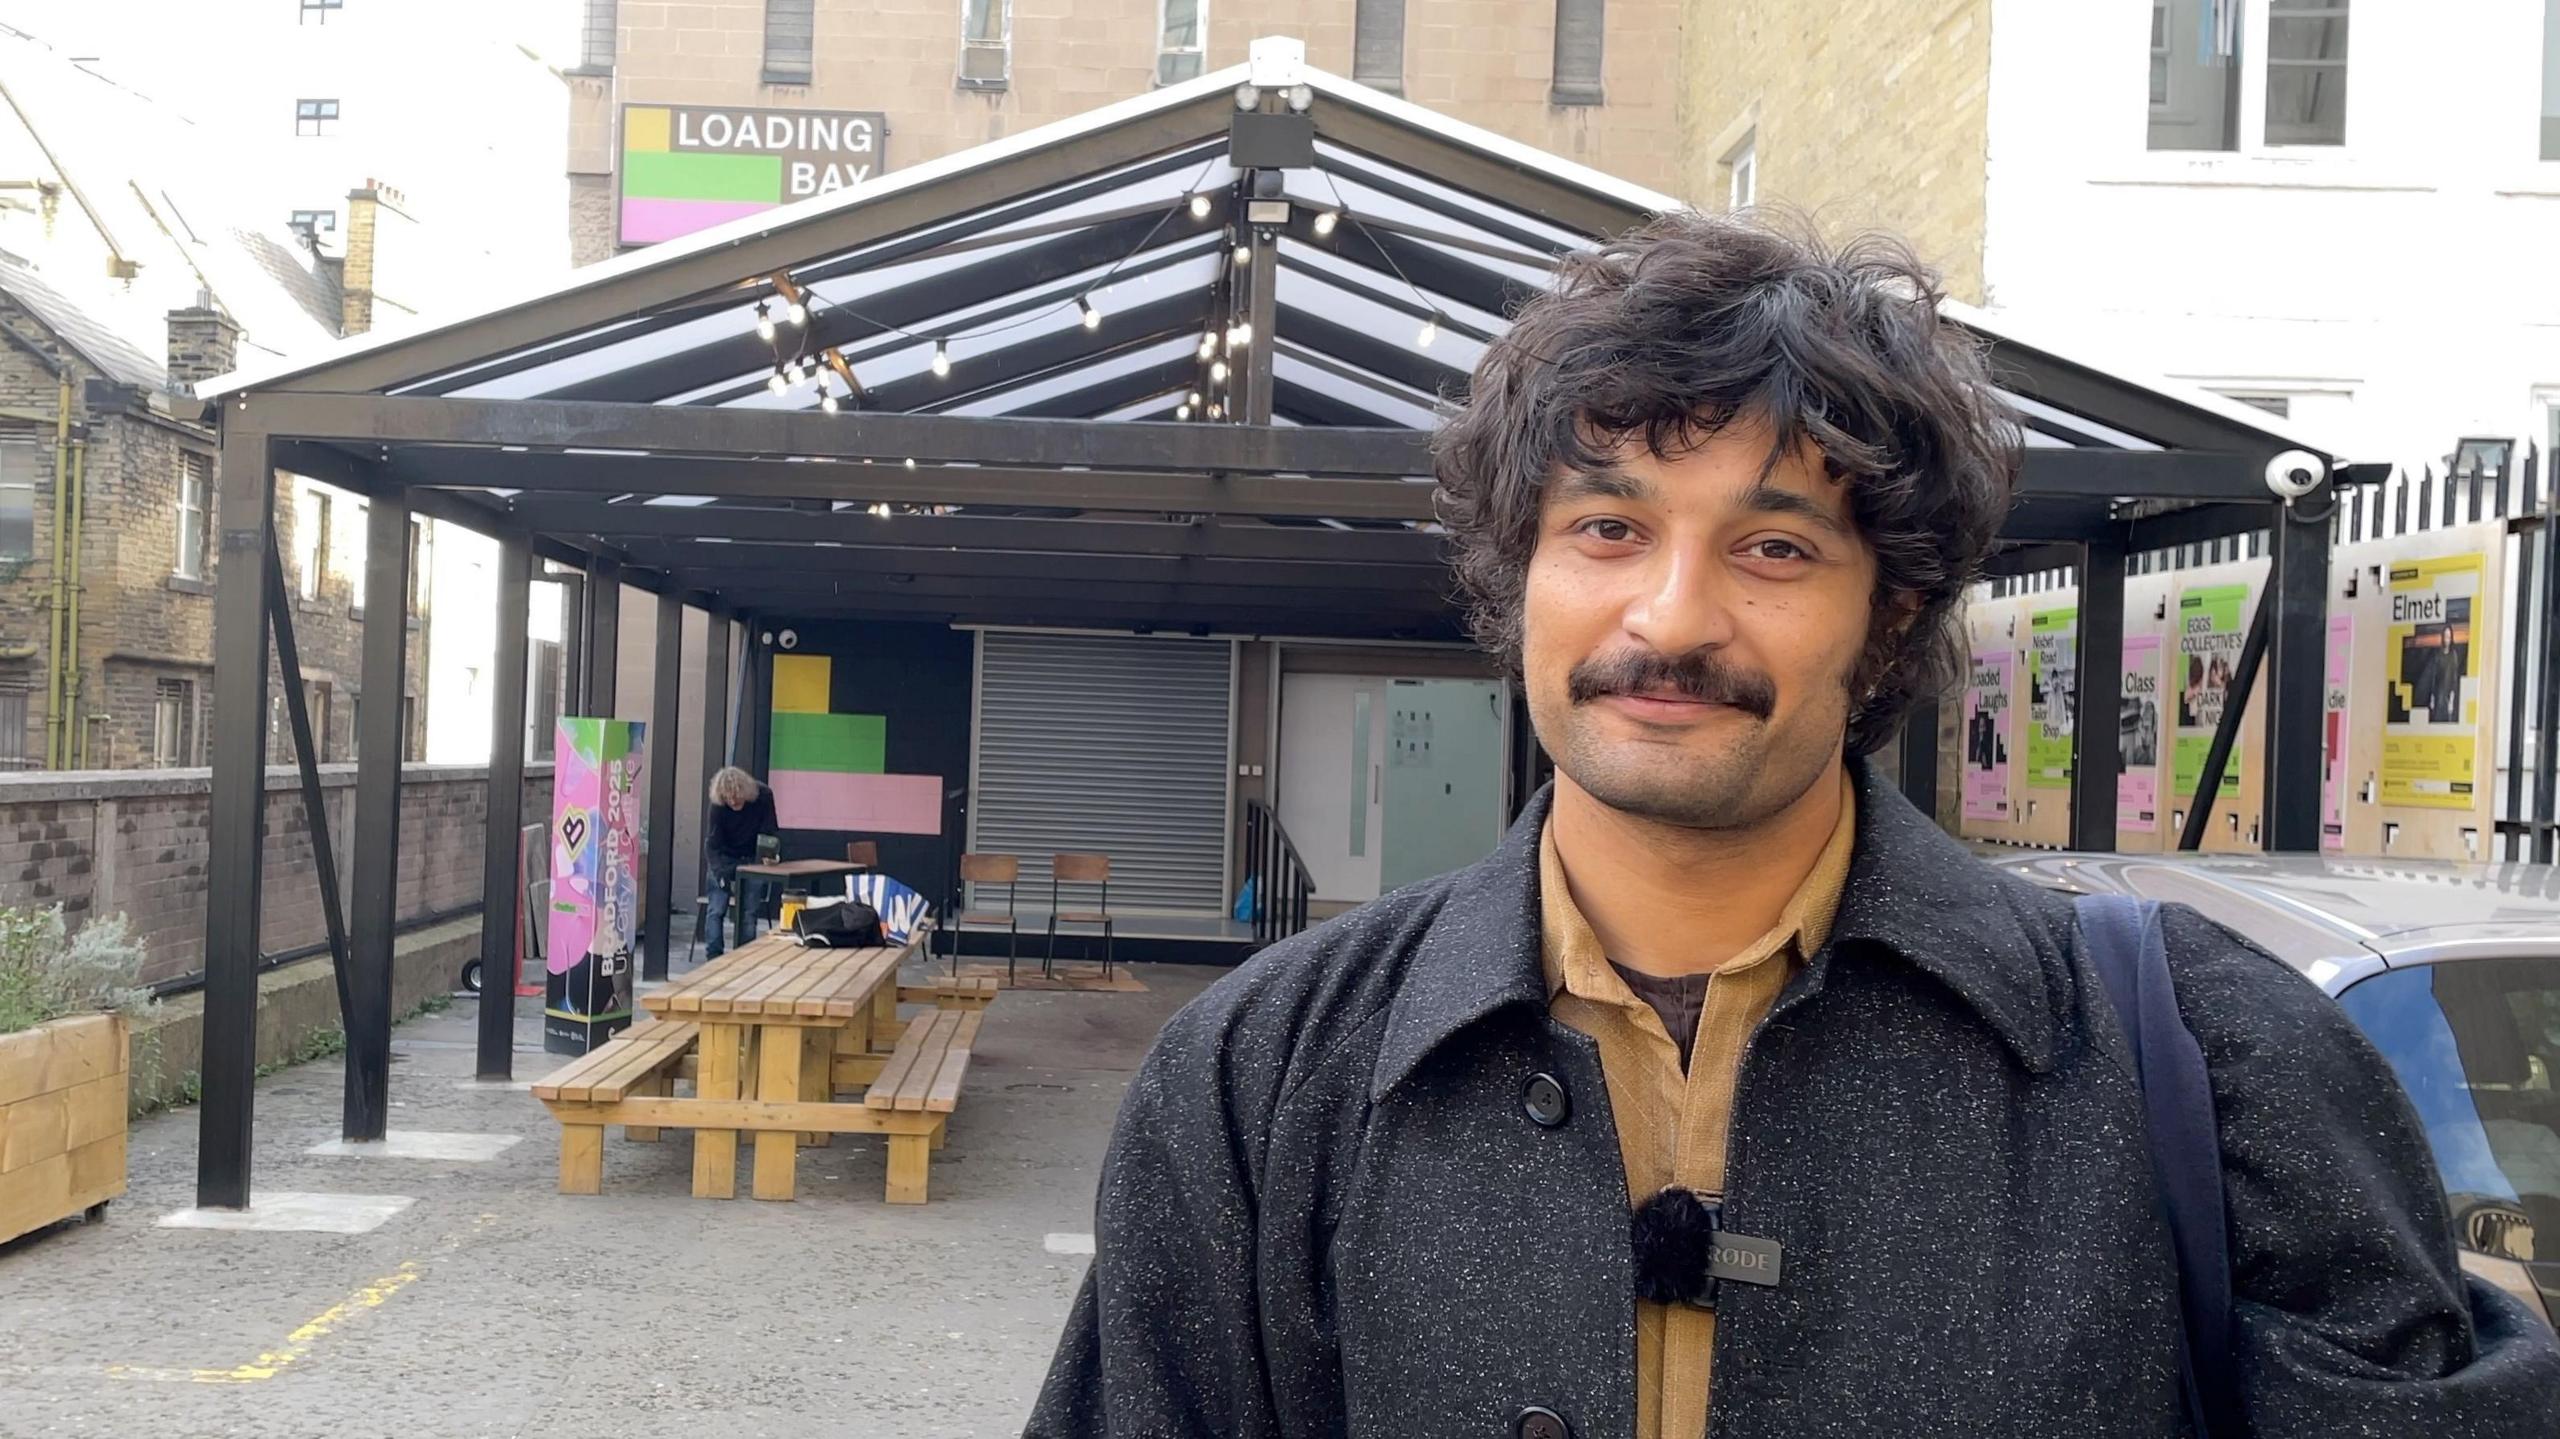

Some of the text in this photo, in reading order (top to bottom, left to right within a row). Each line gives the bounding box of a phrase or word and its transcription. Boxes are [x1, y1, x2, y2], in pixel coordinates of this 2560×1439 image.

[678, 112, 873, 153] LOADING
[791, 162, 870, 195] BAY
[2393, 592, 2442, 621] Elmet
[2187, 617, 2211, 633] EGGS
[2040, 651, 2057, 664] Road
[2125, 673, 2155, 693] Class
[1979, 690, 2008, 714] Laughs
[2205, 710, 2223, 725] NIG
[2043, 723, 2059, 740] Shop
[601, 759, 622, 977] BRADFORD 2025
[618, 852, 632, 879] of
[615, 884, 632, 933] City
[615, 940, 628, 974] UK
